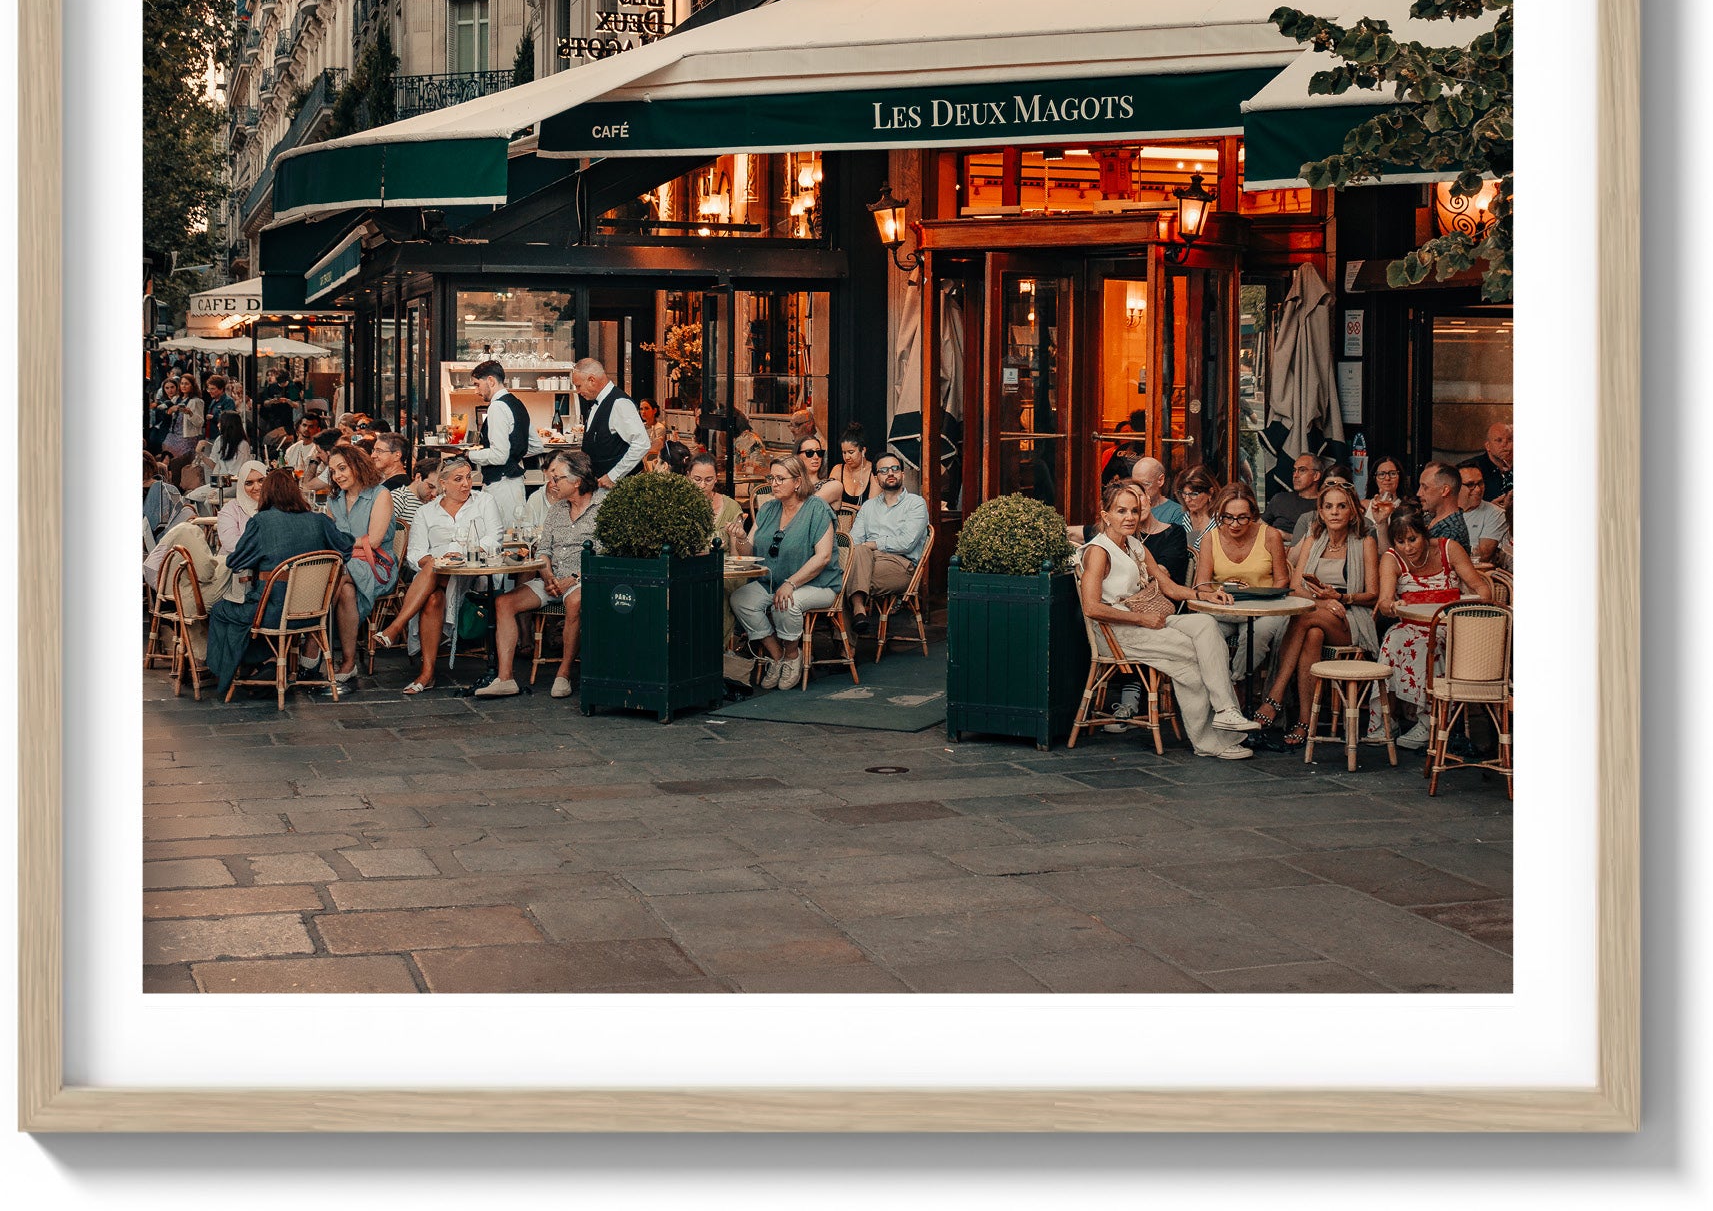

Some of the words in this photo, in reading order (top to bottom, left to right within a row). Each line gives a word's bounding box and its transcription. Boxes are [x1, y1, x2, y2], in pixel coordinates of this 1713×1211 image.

[872, 102, 922, 130] LES
[930, 99, 1007, 128] DEUX
[1012, 93, 1134, 124] MAGOTS
[591, 121, 630, 139] CAFÉ
[197, 298, 237, 311] CAFE
